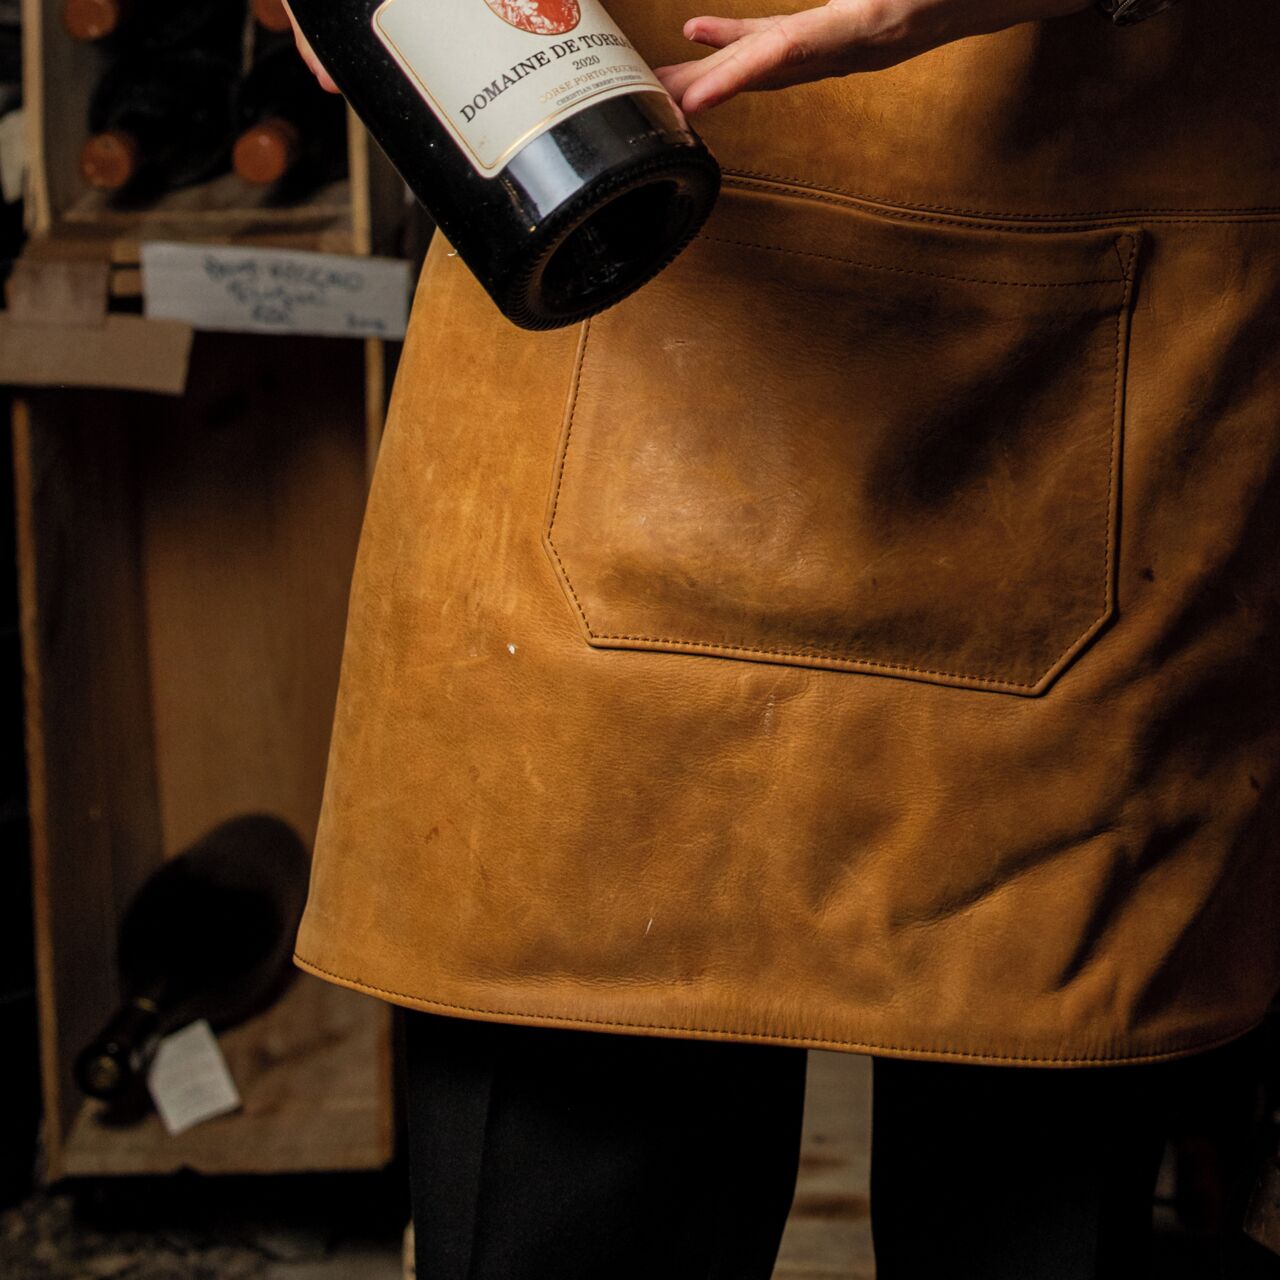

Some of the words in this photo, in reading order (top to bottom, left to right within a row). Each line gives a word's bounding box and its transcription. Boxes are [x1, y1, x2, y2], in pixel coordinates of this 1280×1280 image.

[572, 55, 600, 70] 2020
[459, 51, 550, 123] DOMAINE
[549, 39, 580, 59] DE
[538, 80, 574, 104] CORSE
[556, 85, 592, 106] CHRISTIAN
